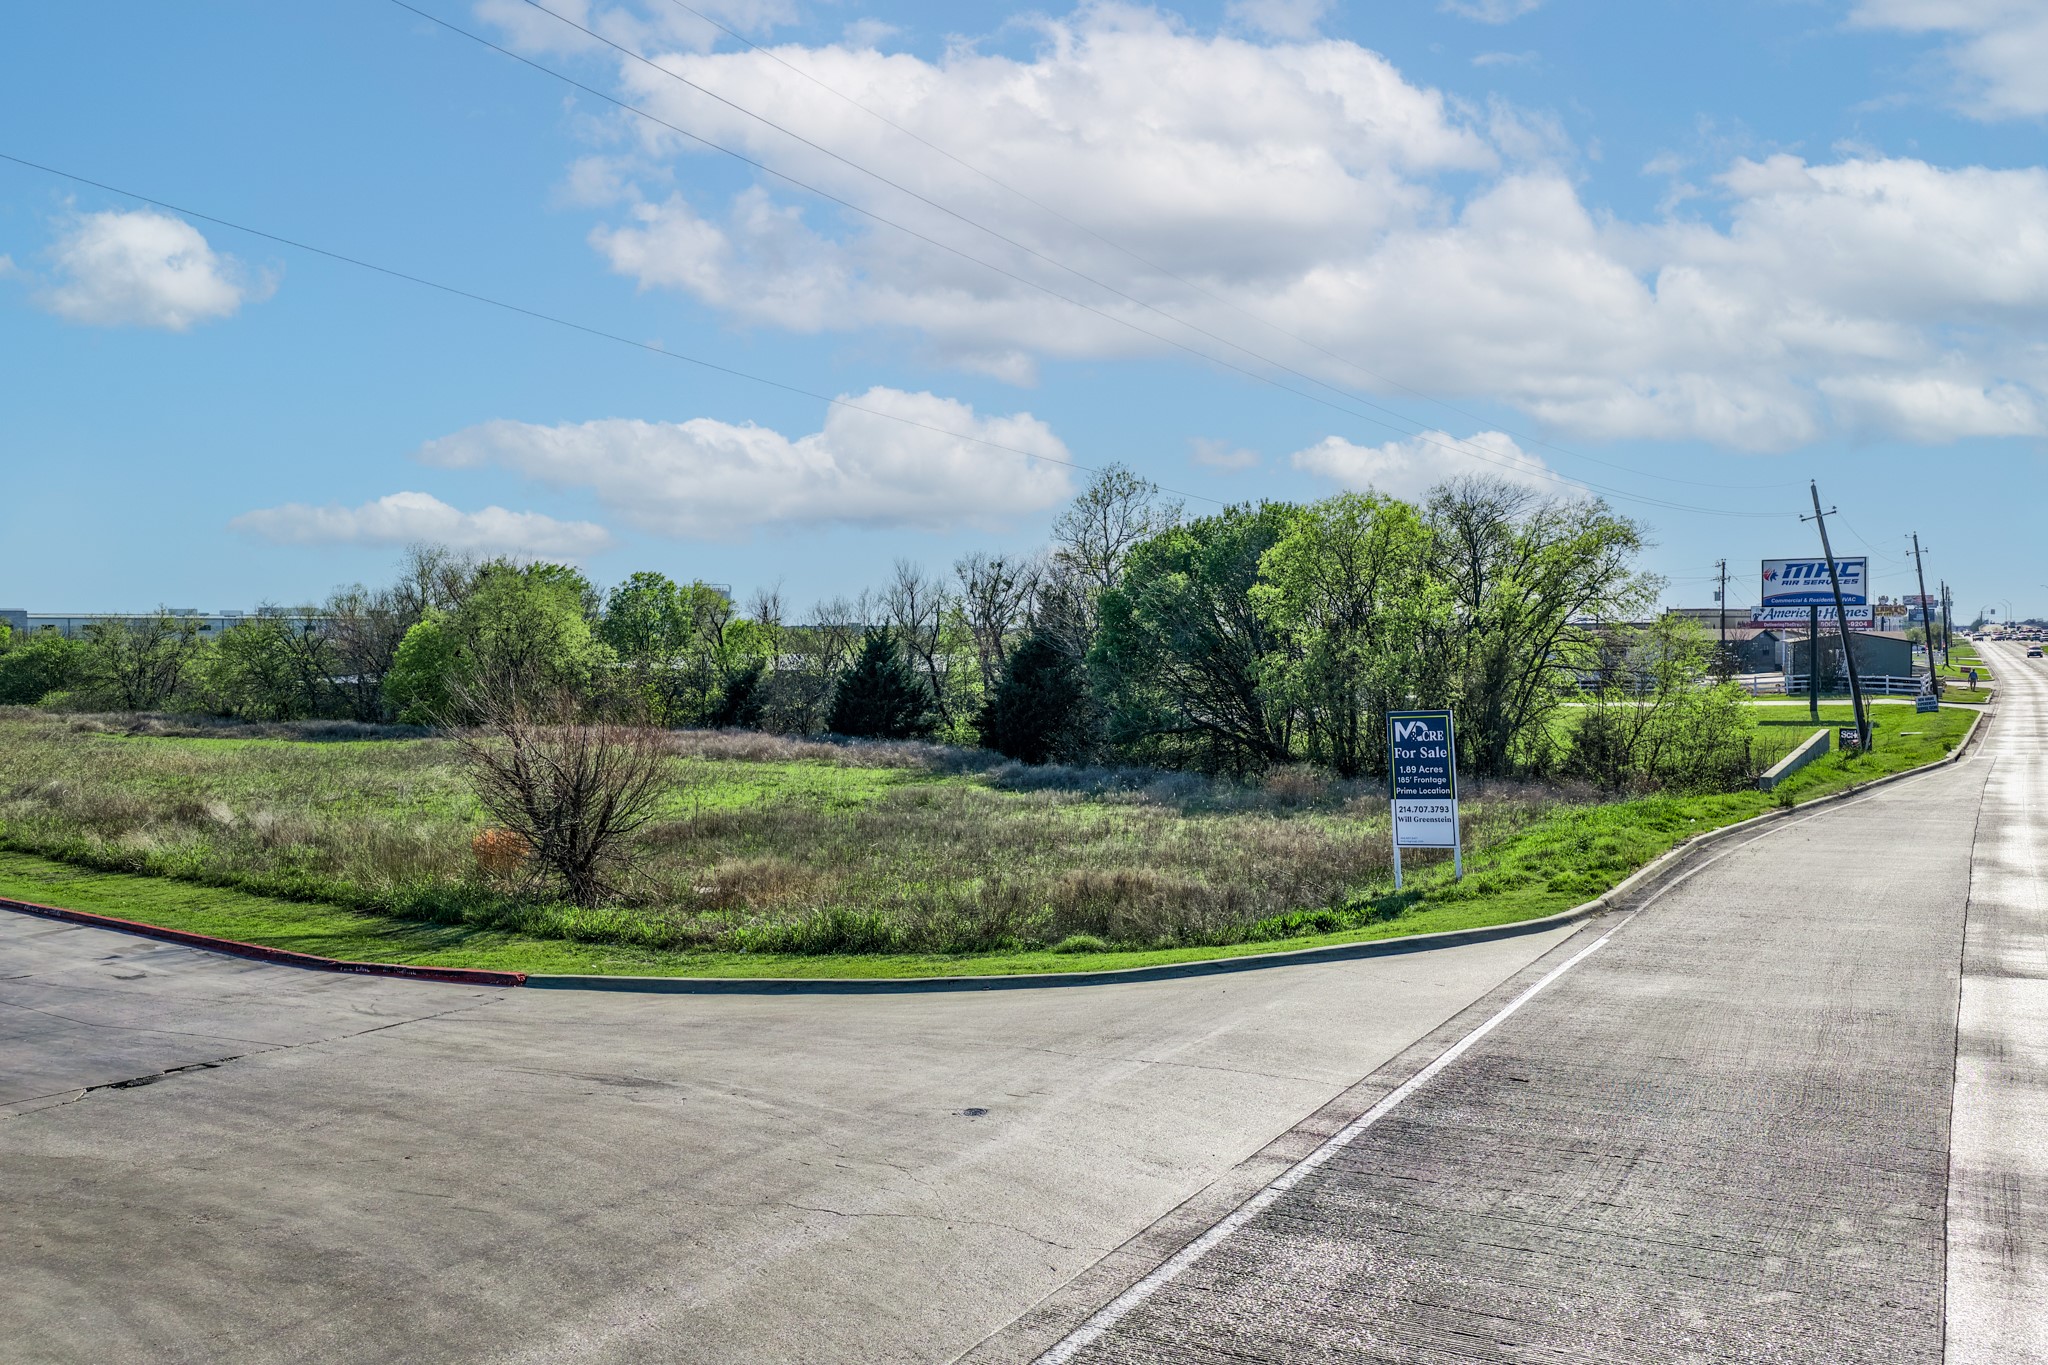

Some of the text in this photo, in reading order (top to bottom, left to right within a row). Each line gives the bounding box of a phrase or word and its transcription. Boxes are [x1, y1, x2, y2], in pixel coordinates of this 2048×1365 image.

[1782, 562, 1864, 578] MHC
[1394, 746, 1447, 759] For Sale
[1418, 765, 1444, 773] Acres
[1413, 776, 1447, 785] Frontage
[1398, 805, 1450, 813] 214.707.3793
